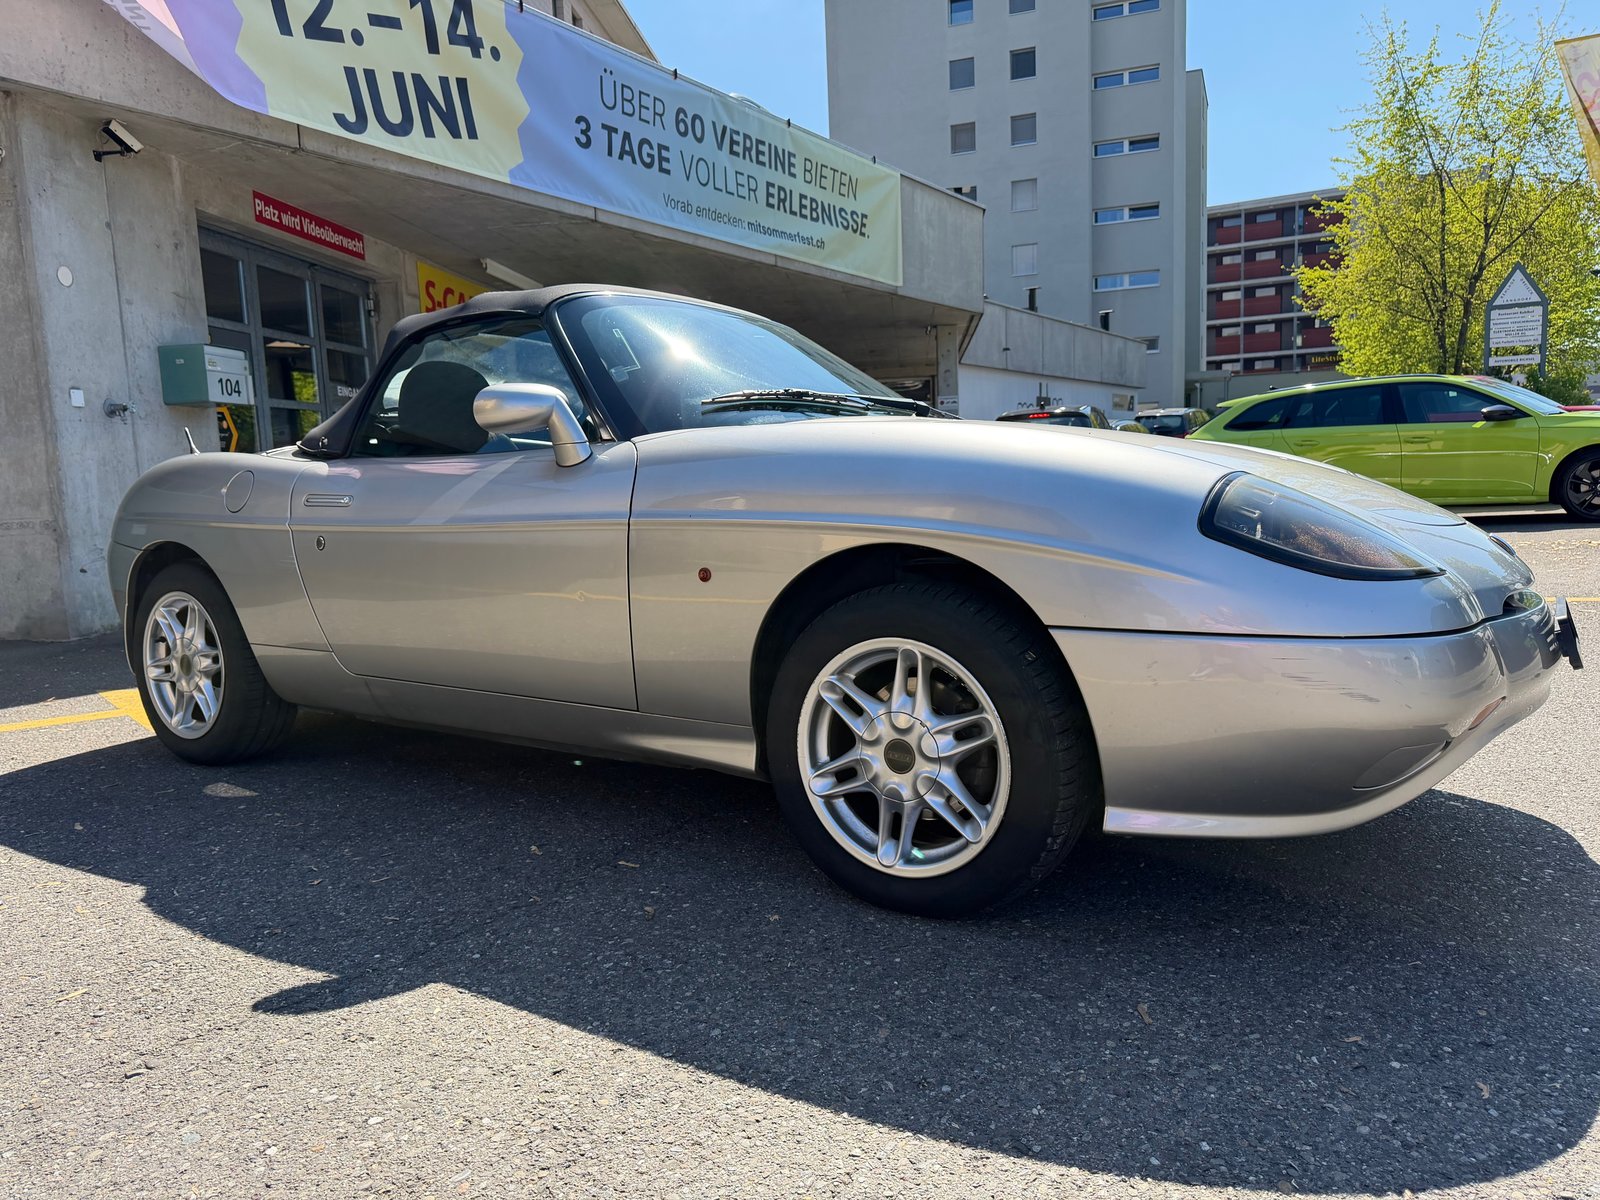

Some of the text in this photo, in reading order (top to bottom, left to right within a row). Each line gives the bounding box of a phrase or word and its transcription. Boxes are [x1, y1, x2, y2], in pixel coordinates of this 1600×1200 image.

[332, 66, 479, 140] JUNI
[600, 68, 859, 201] ÜBER 60 VEREINE BIETEN
[575, 115, 870, 239] 3 TAGE VOLLER ERLEBNISSE.
[255, 198, 364, 254] Platz wird Videoüberwacht
[662, 192, 825, 250] Vorab entdecken: mitsommerfest.ch
[218, 378, 241, 397] 104
